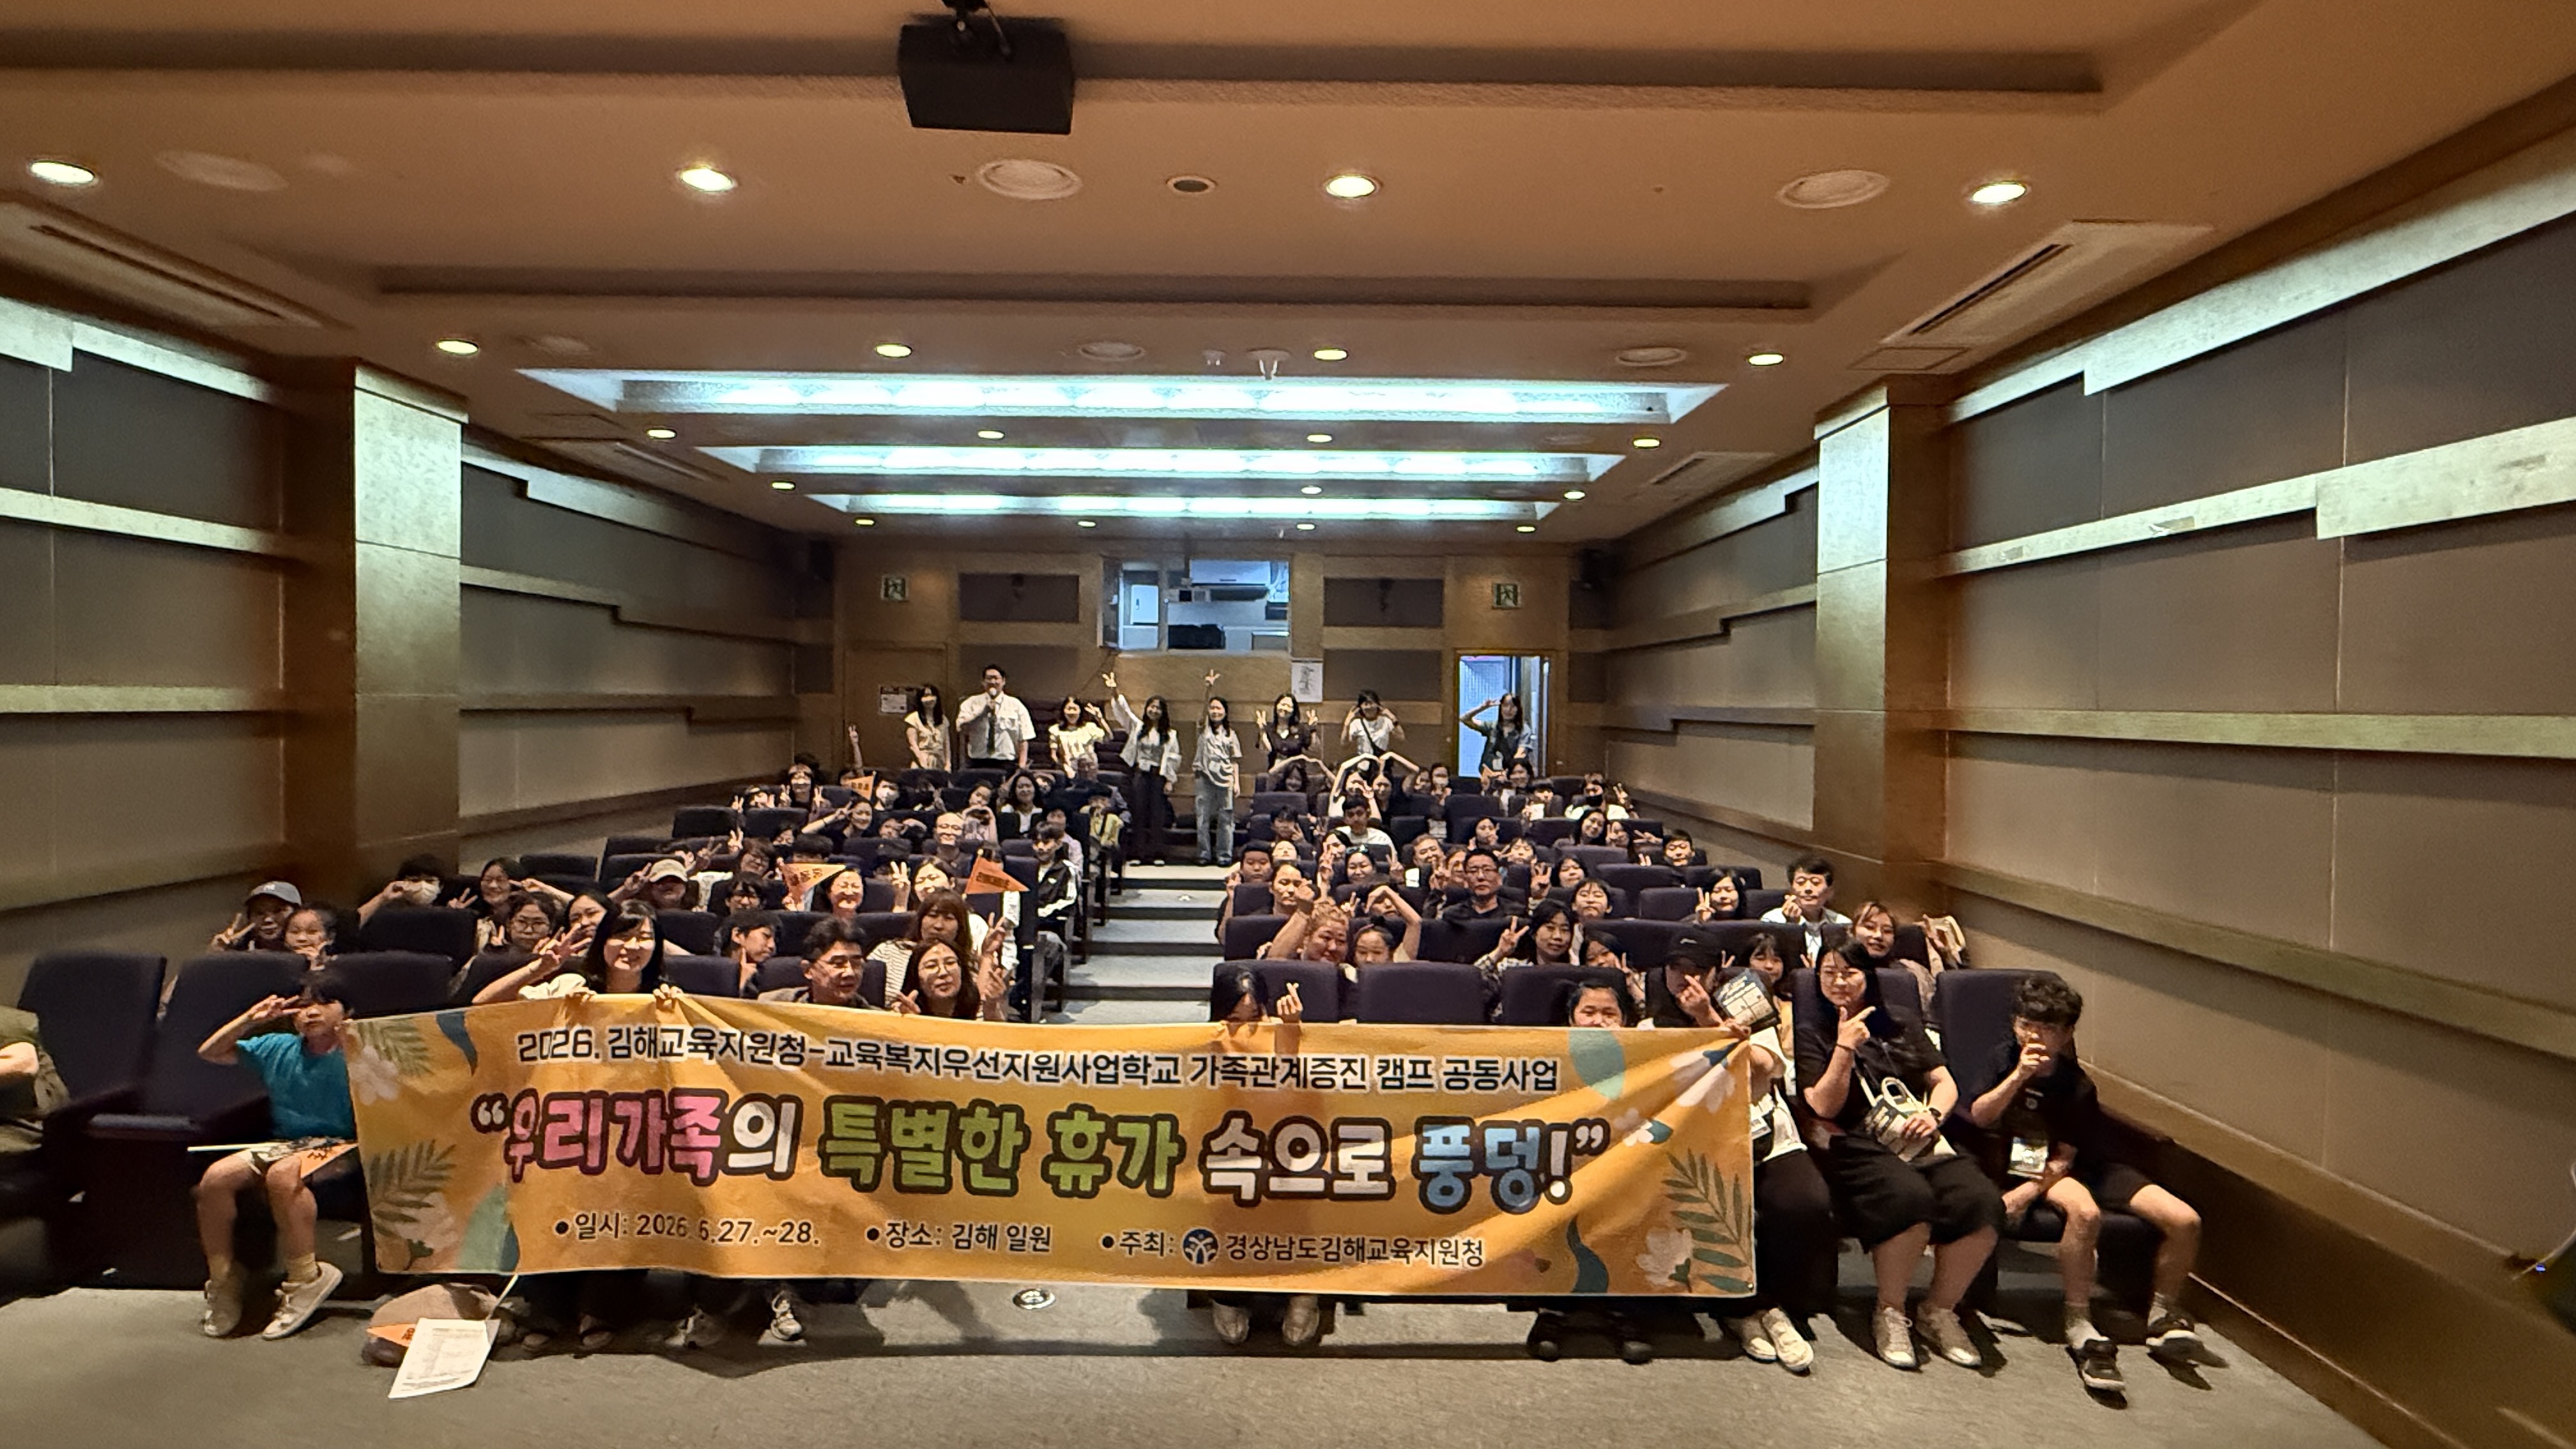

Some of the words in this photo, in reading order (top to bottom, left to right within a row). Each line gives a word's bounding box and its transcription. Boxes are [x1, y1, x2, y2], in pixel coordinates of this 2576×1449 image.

[518, 1029, 600, 1062] 2026.
[608, 1026, 1181, 1085] 김해교육지원청-교육복지우선지원사업학교
[1190, 1055, 1366, 1091] 가족관계증진
[1376, 1057, 1435, 1091] 캠프
[1443, 1059, 1558, 1092] 공동사업
[818, 1095, 1031, 1197] 특별한
[1041, 1103, 1186, 1198] 휴가
[1198, 1109, 1396, 1208] 속으로
[575, 1212, 628, 1240] 일시:
[885, 1221, 942, 1249] 장소:
[951, 1223, 998, 1250] 김해
[1006, 1225, 1051, 1252] 일원
[1119, 1230, 1175, 1257] 주최:
[1225, 1234, 1483, 1268] 경상남도김해교육지원청
